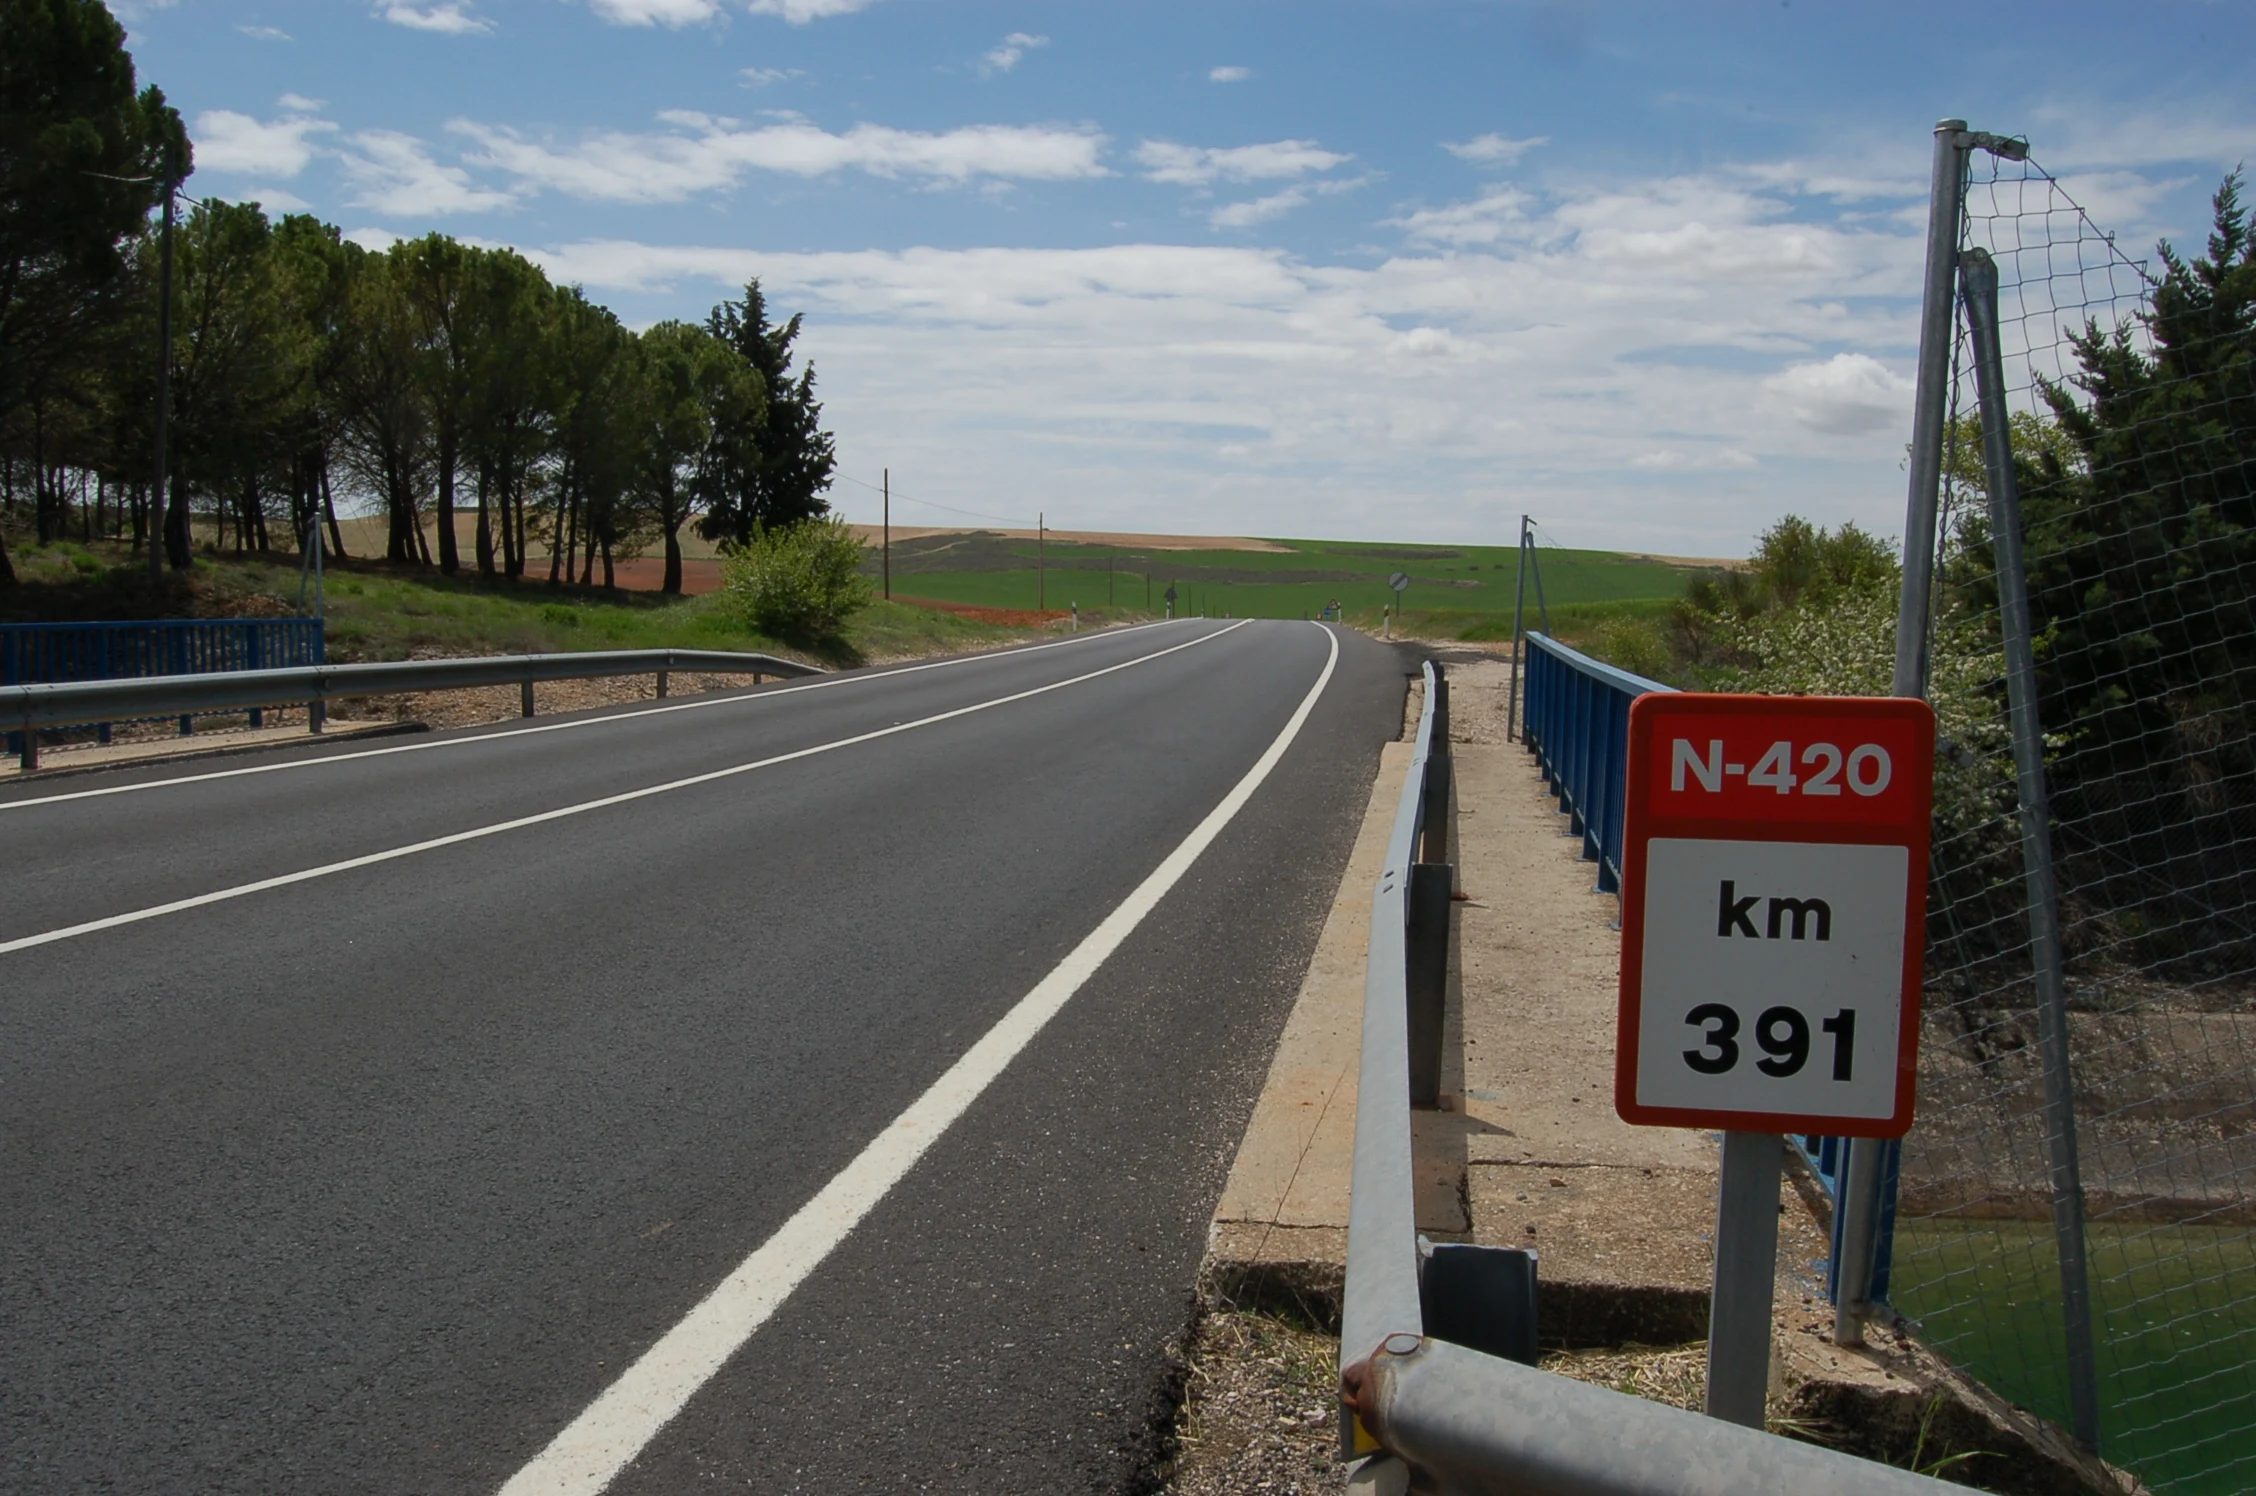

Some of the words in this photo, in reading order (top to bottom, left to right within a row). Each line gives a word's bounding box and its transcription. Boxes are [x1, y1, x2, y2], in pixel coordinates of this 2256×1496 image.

[1670, 738, 1892, 796] N-420
[1717, 880, 1832, 941] km
[1682, 1003, 1856, 1081] 391
